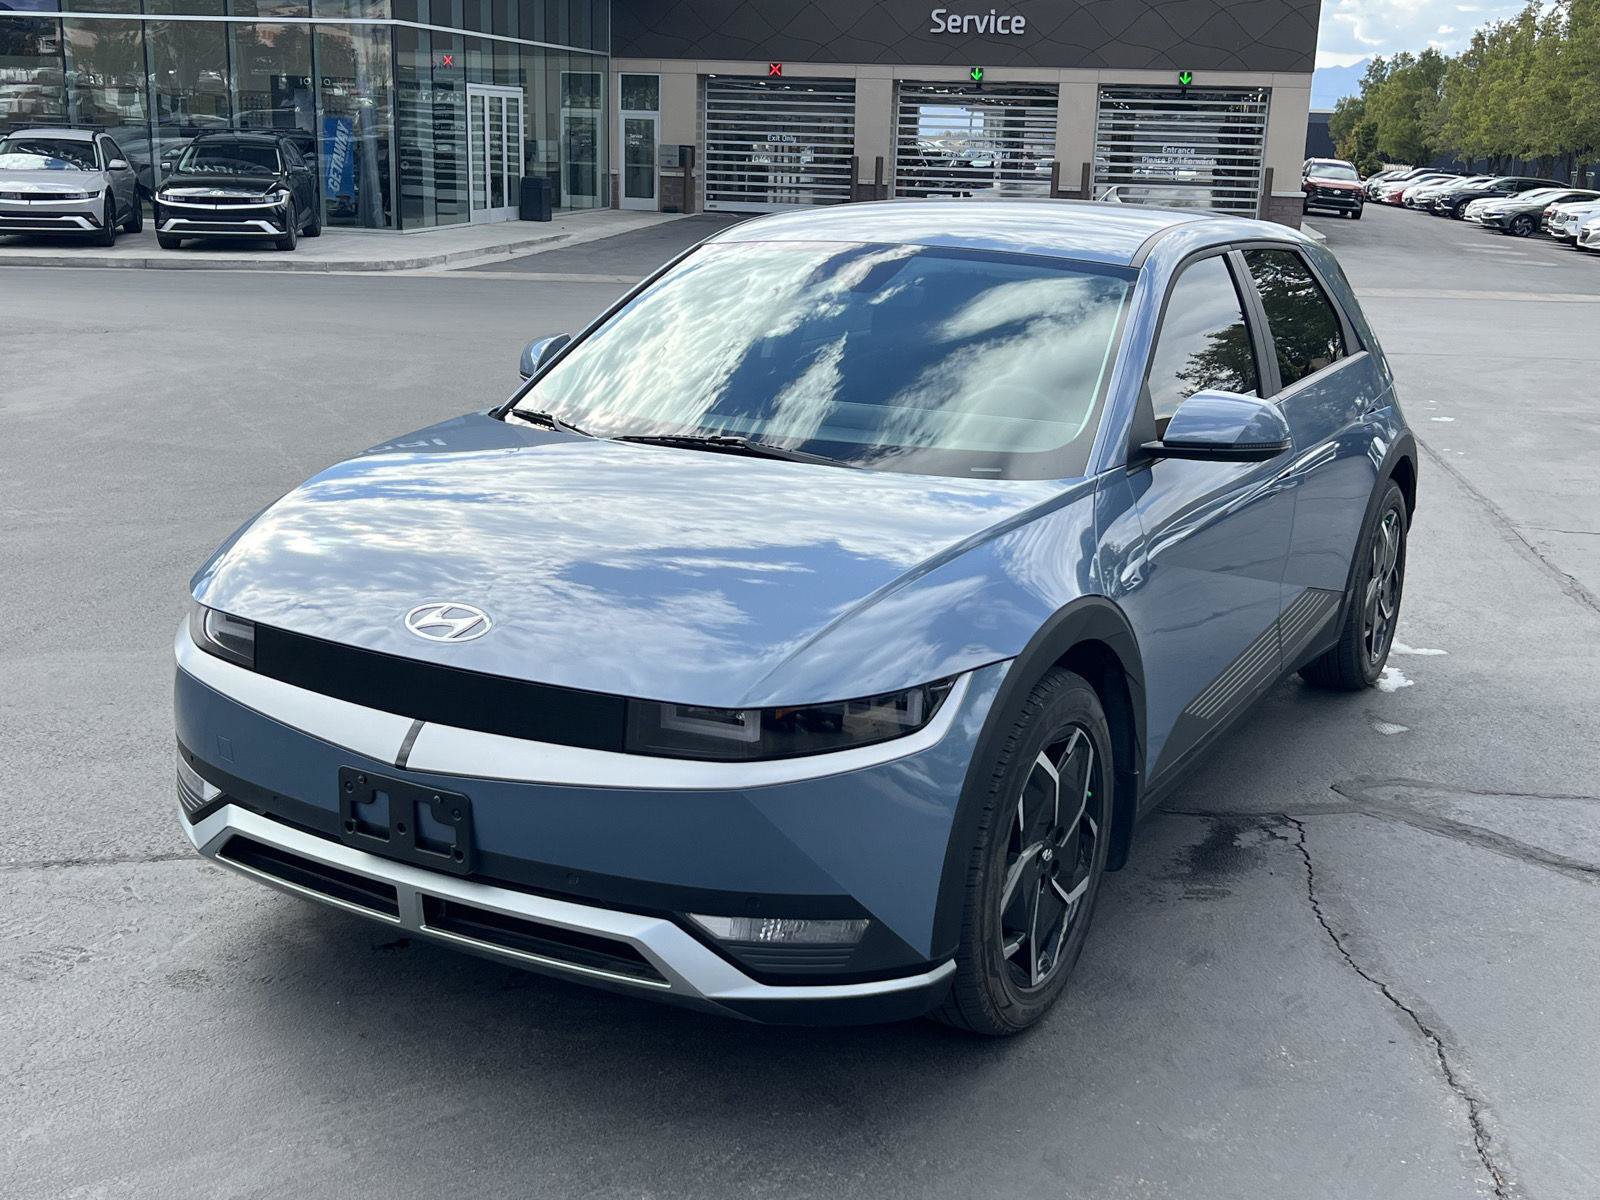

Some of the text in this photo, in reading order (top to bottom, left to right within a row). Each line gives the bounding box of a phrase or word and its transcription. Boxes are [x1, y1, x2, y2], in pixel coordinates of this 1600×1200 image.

[929, 8, 1026, 35] Service
[768, 134, 797, 144] Exit Only
[327, 119, 349, 192] GETAWAY
[1162, 146, 1196, 154] Entrance
